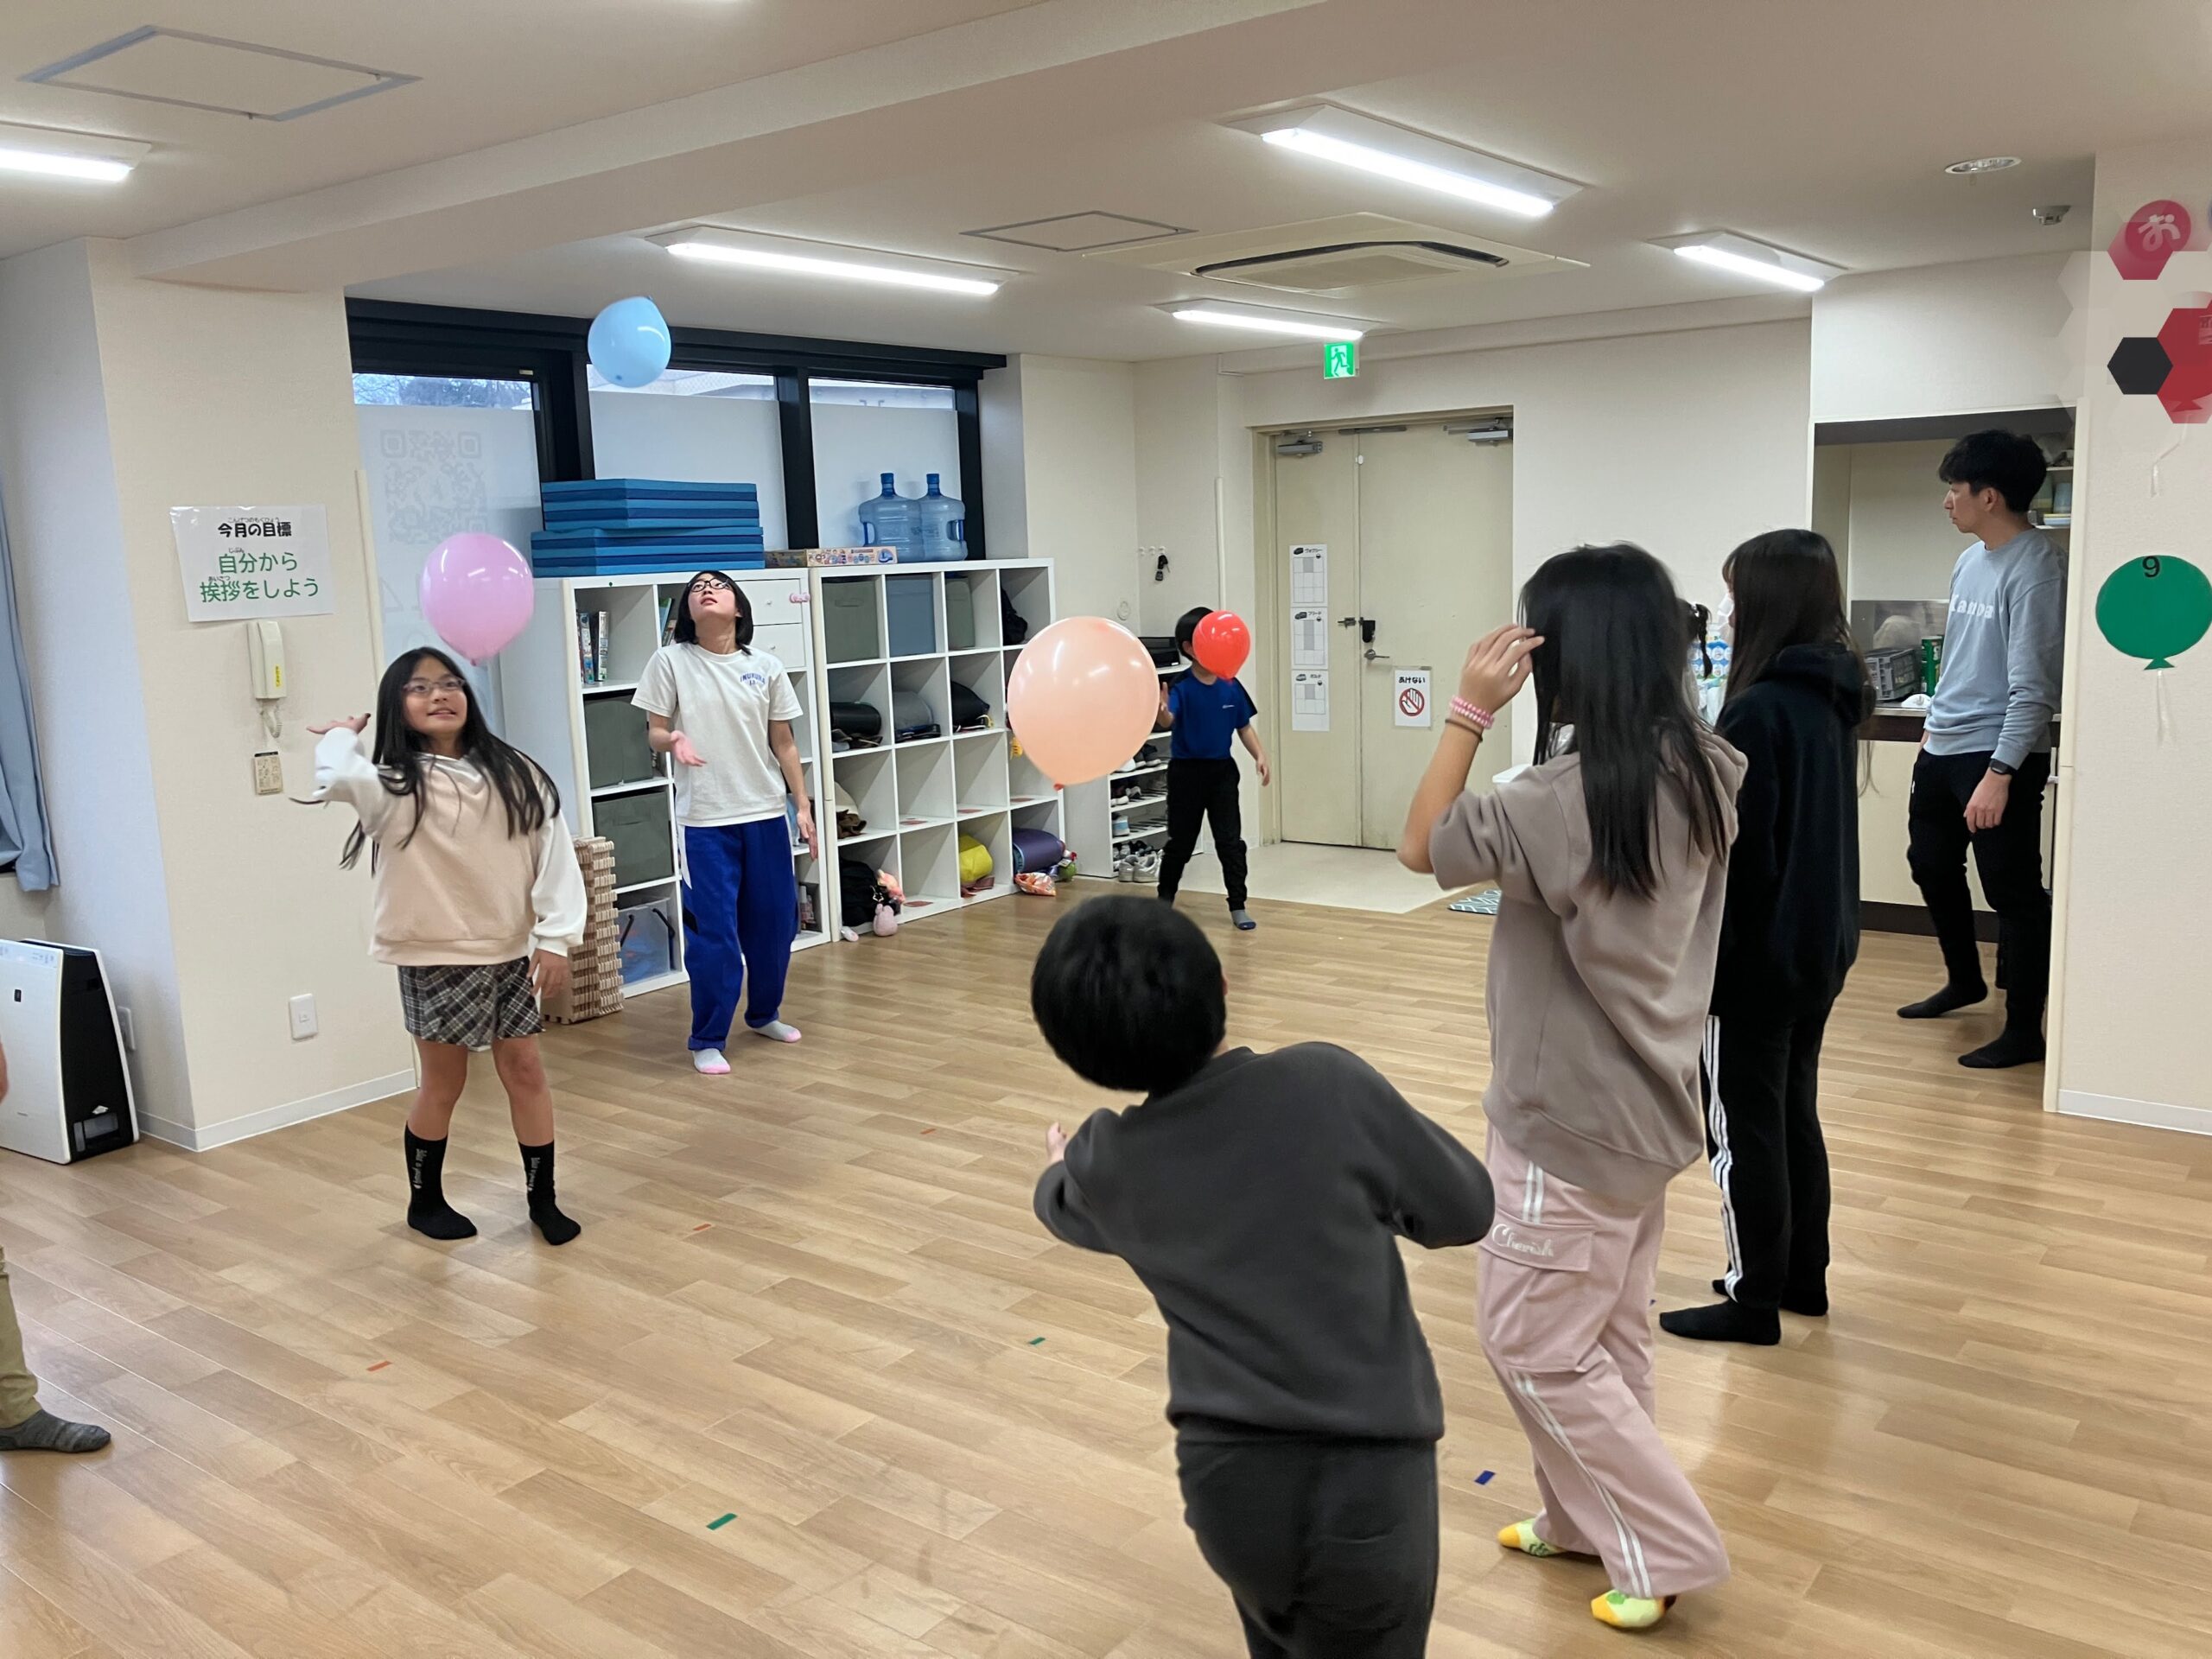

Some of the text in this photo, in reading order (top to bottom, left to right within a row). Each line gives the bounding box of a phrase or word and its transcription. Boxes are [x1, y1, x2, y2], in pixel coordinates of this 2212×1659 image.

[2138, 213, 2181, 251] お
[218, 522, 292, 537] 今月の目標
[219, 551, 297, 574] 自分から
[2142, 556, 2160, 577] 9
[200, 577, 319, 602] 挨拶をしよう
